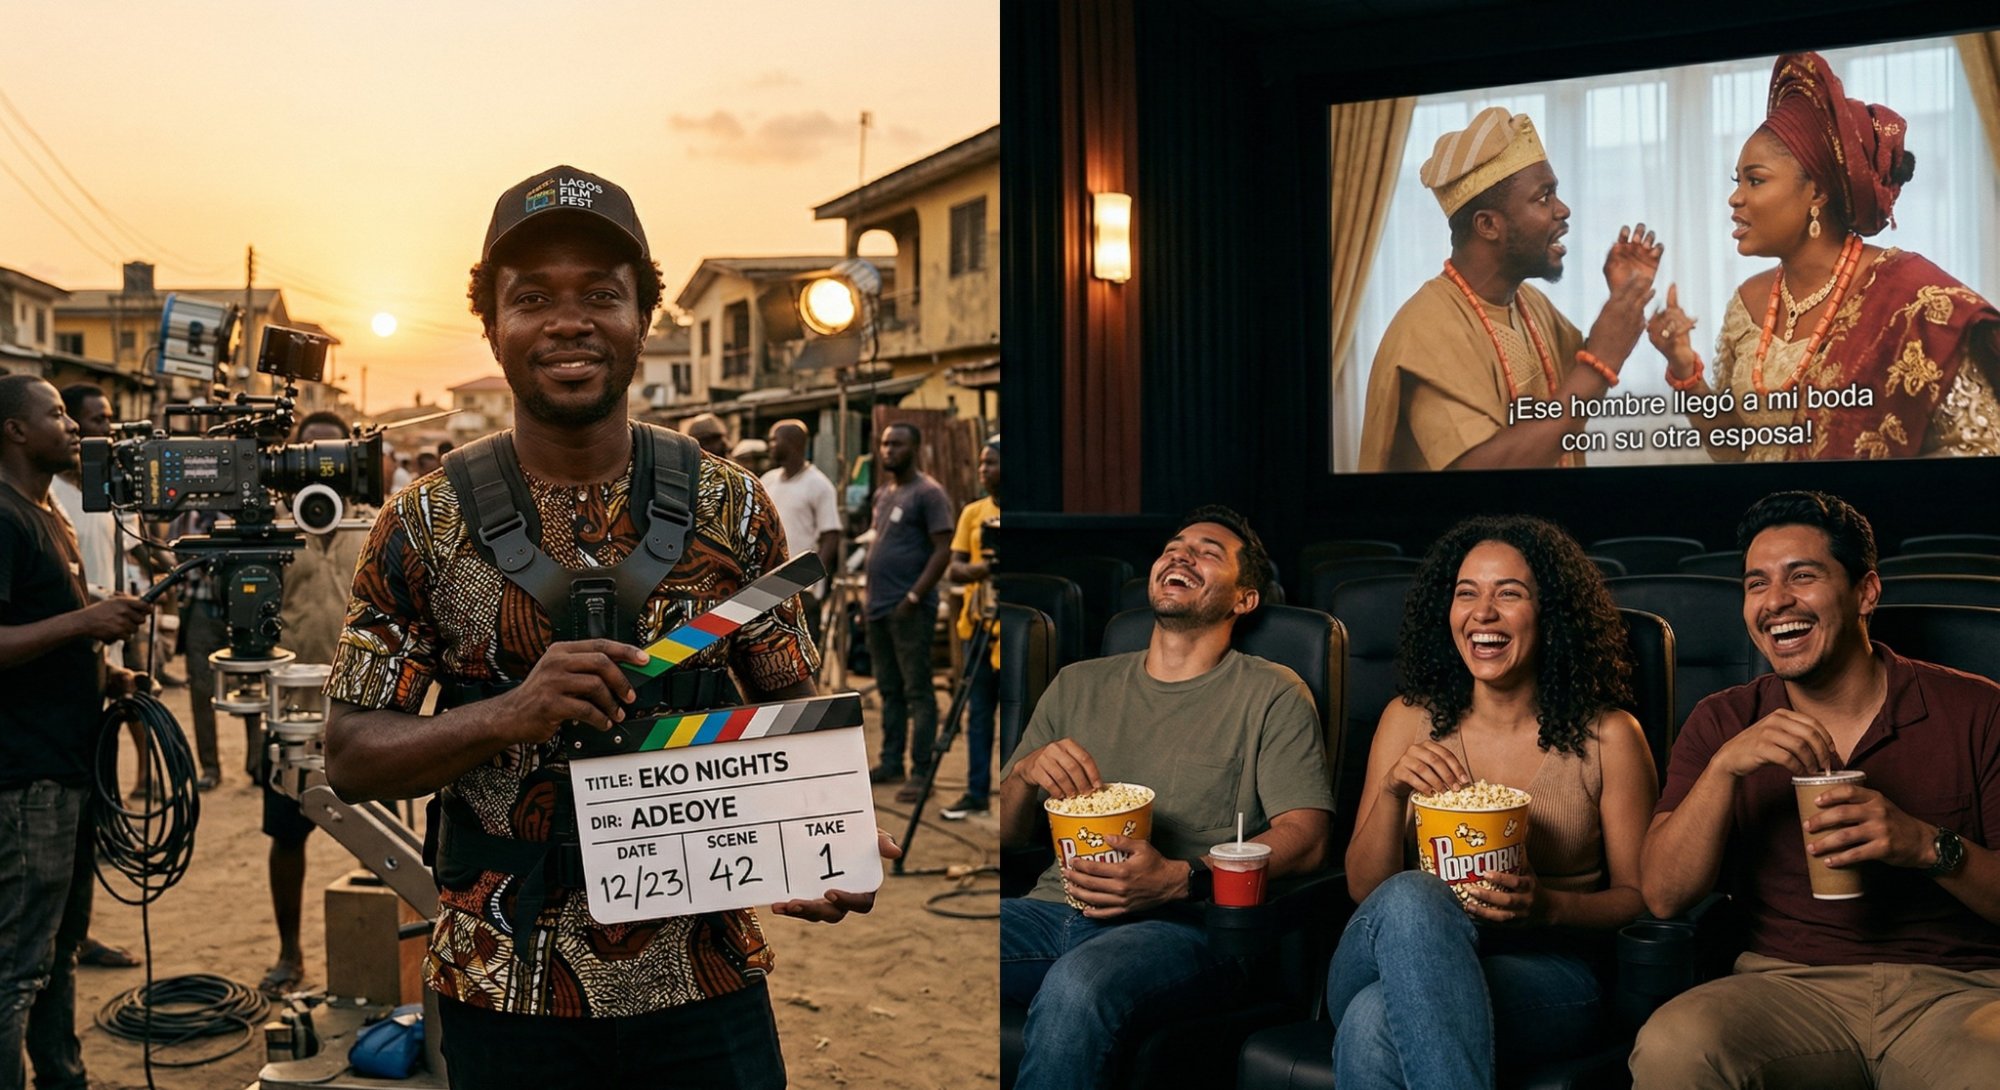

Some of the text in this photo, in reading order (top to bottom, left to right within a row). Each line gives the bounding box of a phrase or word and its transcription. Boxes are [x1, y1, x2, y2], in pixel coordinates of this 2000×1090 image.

[559, 178, 603, 194] LAGOS
[560, 187, 591, 199] FILM
[560, 197, 593, 208] FEST
[1508, 383, 1874, 425] ¡Ese hombre llegó a mi boda
[1562, 420, 1813, 451] con su otra esposa!
[320, 465, 335, 477] 35
[585, 751, 789, 791] TITLE: EKO NIGHTS
[591, 796, 738, 830] DIR: ADEOYE
[805, 820, 846, 837] TAKE
[617, 843, 657, 860] DATE
[707, 831, 758, 848] SCENE
[709, 856, 763, 891] 42
[818, 843, 845, 880] 1
[1429, 837, 1520, 882] POPCORN
[600, 865, 684, 910] 12/23
